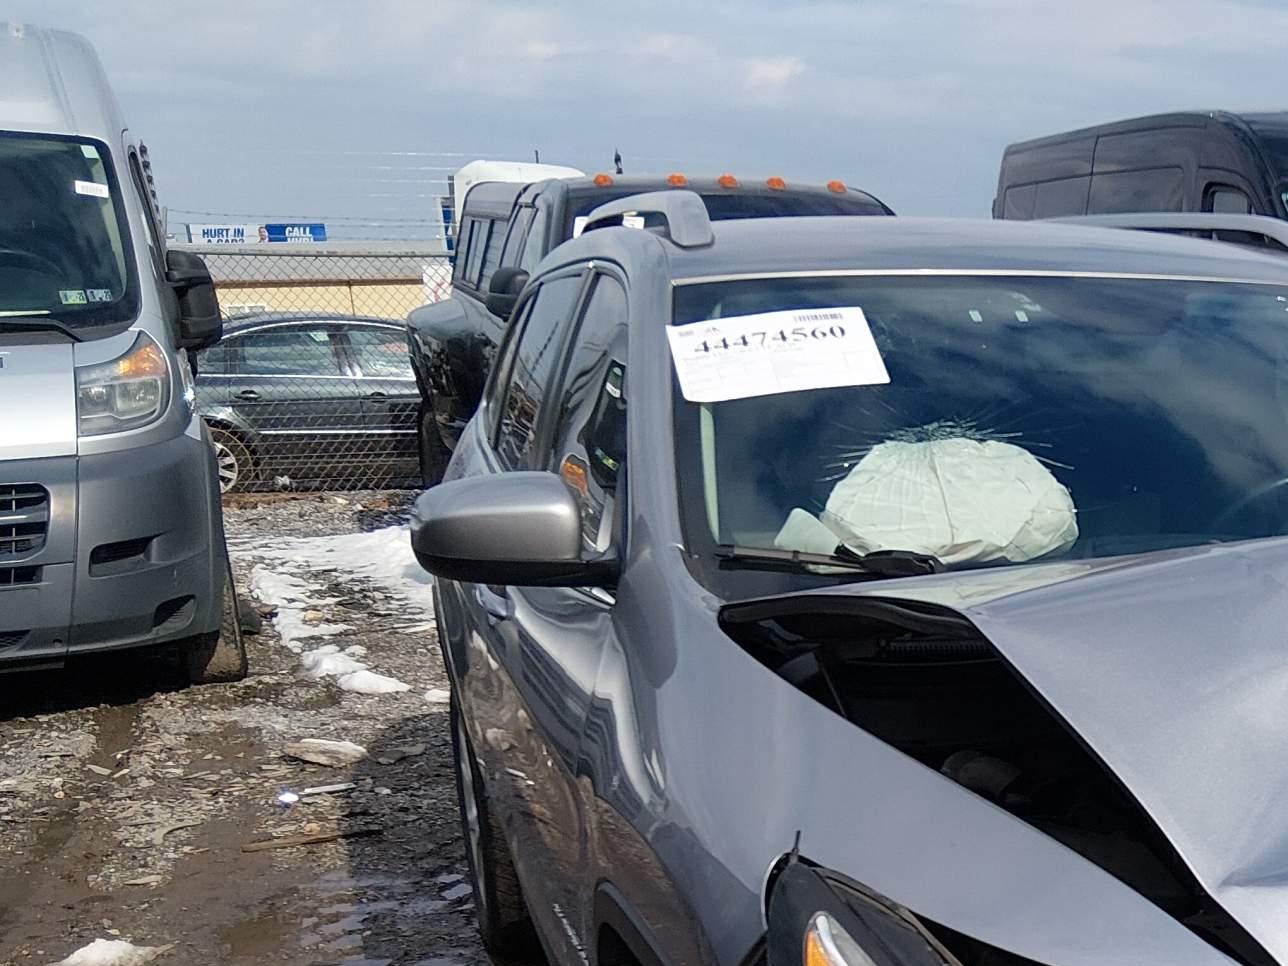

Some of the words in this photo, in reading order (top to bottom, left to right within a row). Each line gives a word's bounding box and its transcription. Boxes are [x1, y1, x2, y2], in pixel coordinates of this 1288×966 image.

[202, 228, 230, 239] HURT
[233, 227, 245, 238] IN
[285, 226, 313, 237] CALL
[694, 324, 847, 353] 44474560
